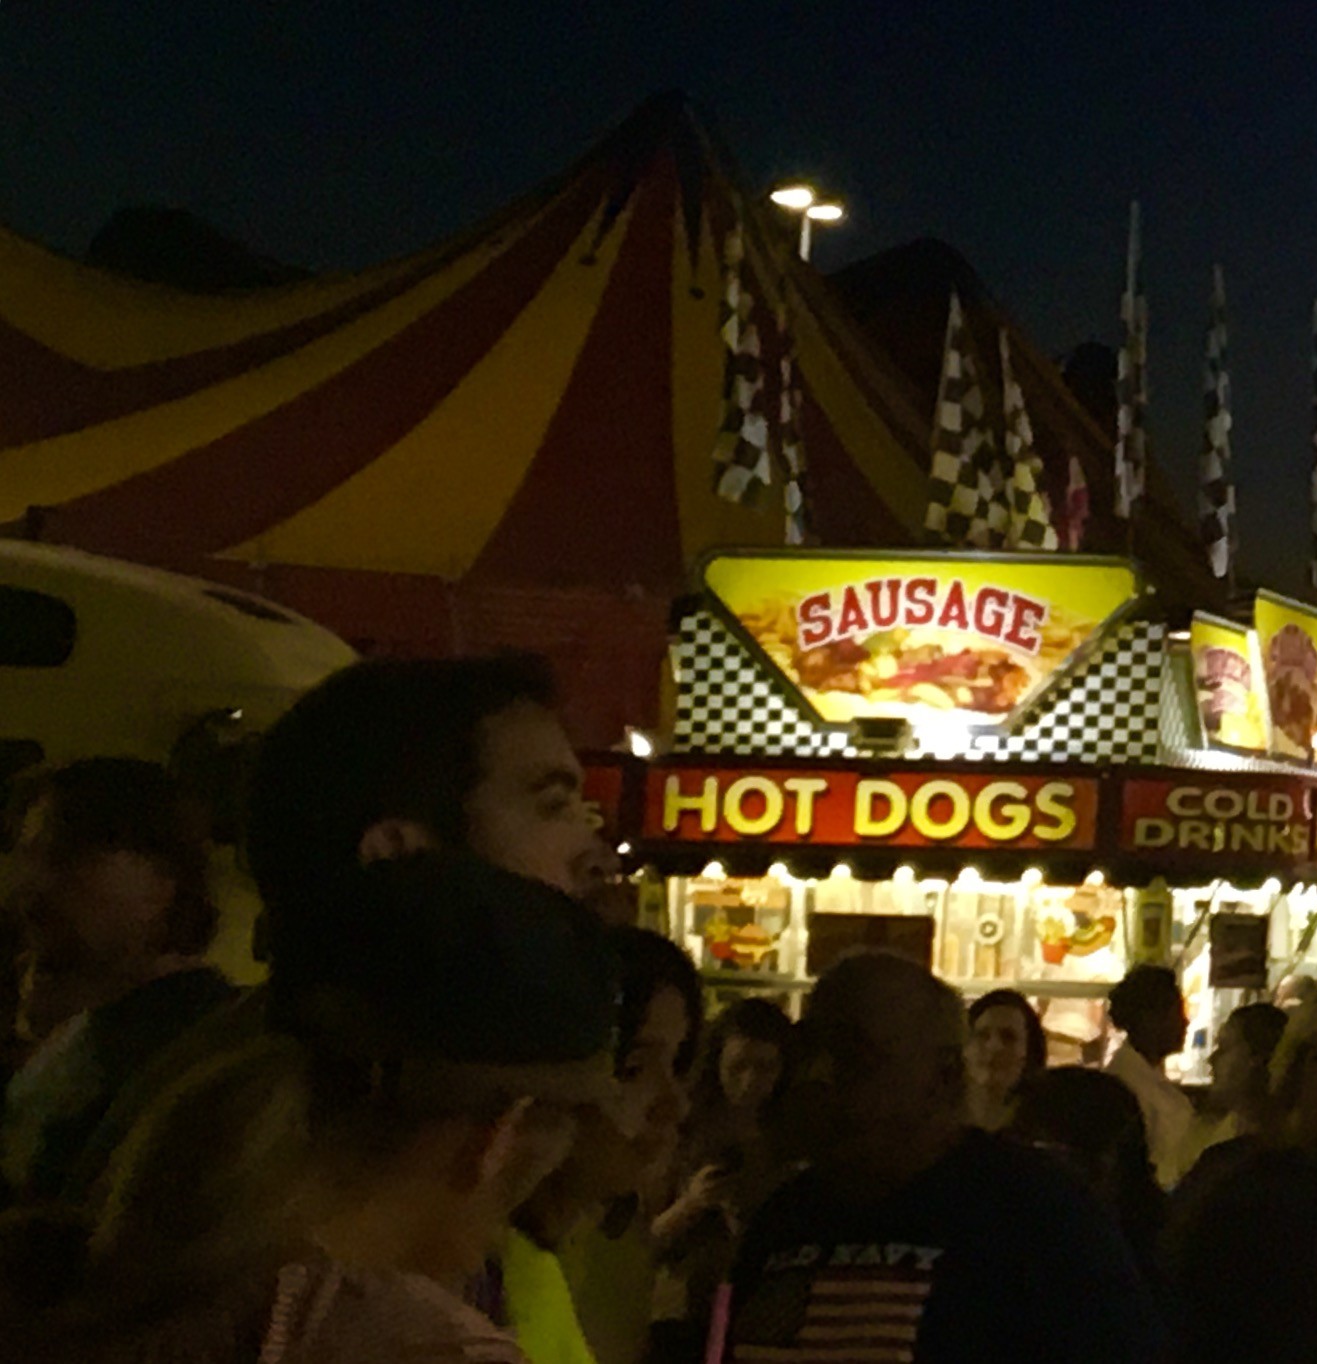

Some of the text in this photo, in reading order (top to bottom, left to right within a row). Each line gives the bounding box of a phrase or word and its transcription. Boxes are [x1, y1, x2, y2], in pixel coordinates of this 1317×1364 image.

[799, 577, 1045, 654] SAUSAGE
[662, 775, 1077, 840] HOT DOGS
[1165, 786, 1294, 822] COLD
[1134, 818, 1308, 855] DRINKS
